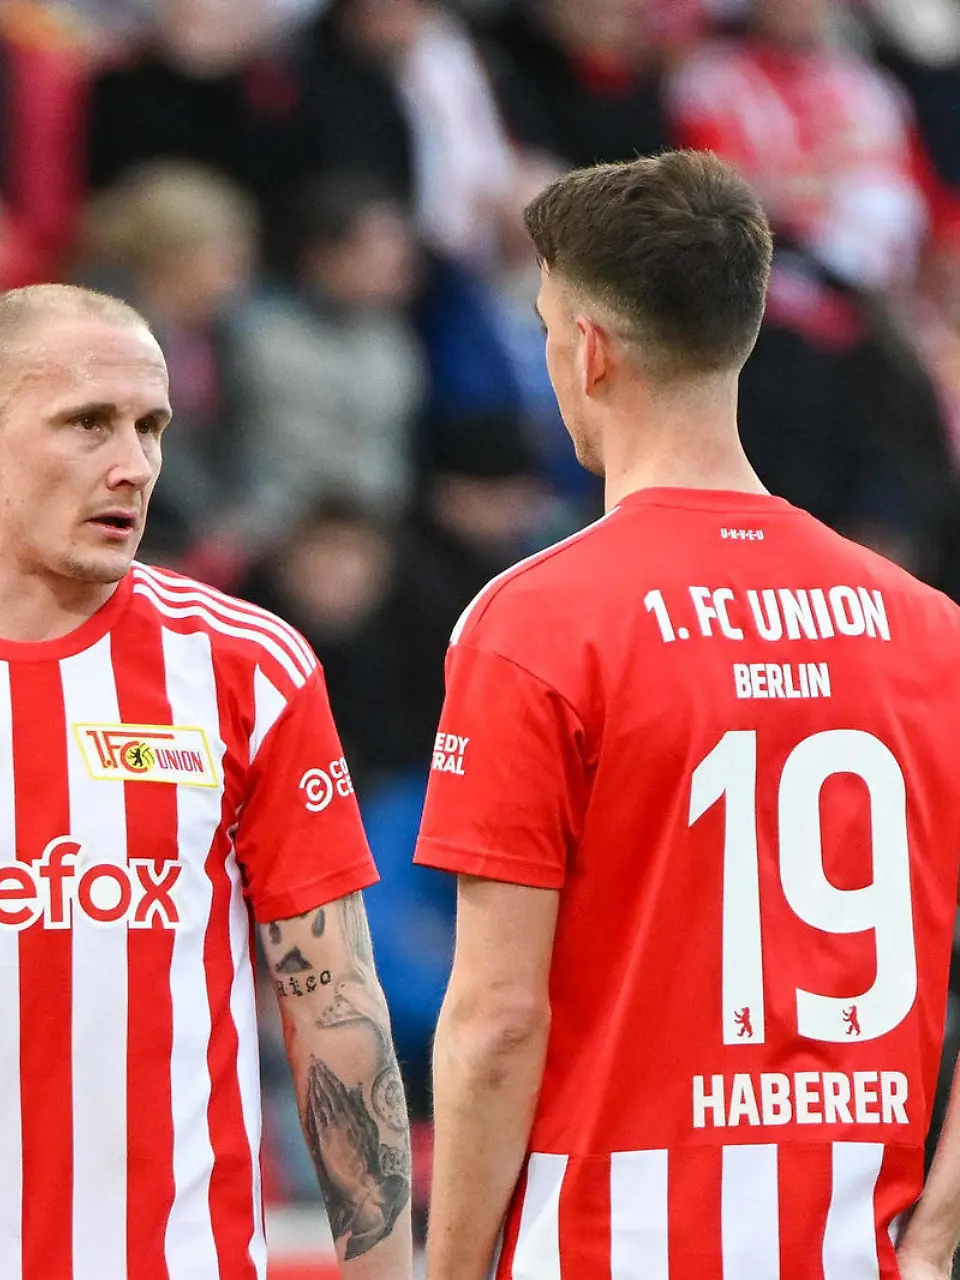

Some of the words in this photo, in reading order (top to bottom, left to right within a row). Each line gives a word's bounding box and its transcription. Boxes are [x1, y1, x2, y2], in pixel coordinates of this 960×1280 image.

[643, 589, 690, 643] 1.
[689, 586, 744, 640] FC
[746, 585, 891, 641] UNION
[733, 663, 831, 699] BERLIN
[155, 748, 205, 773] UNION
[688, 729, 918, 1045] 19
[692, 1070, 910, 1129] HABERER
